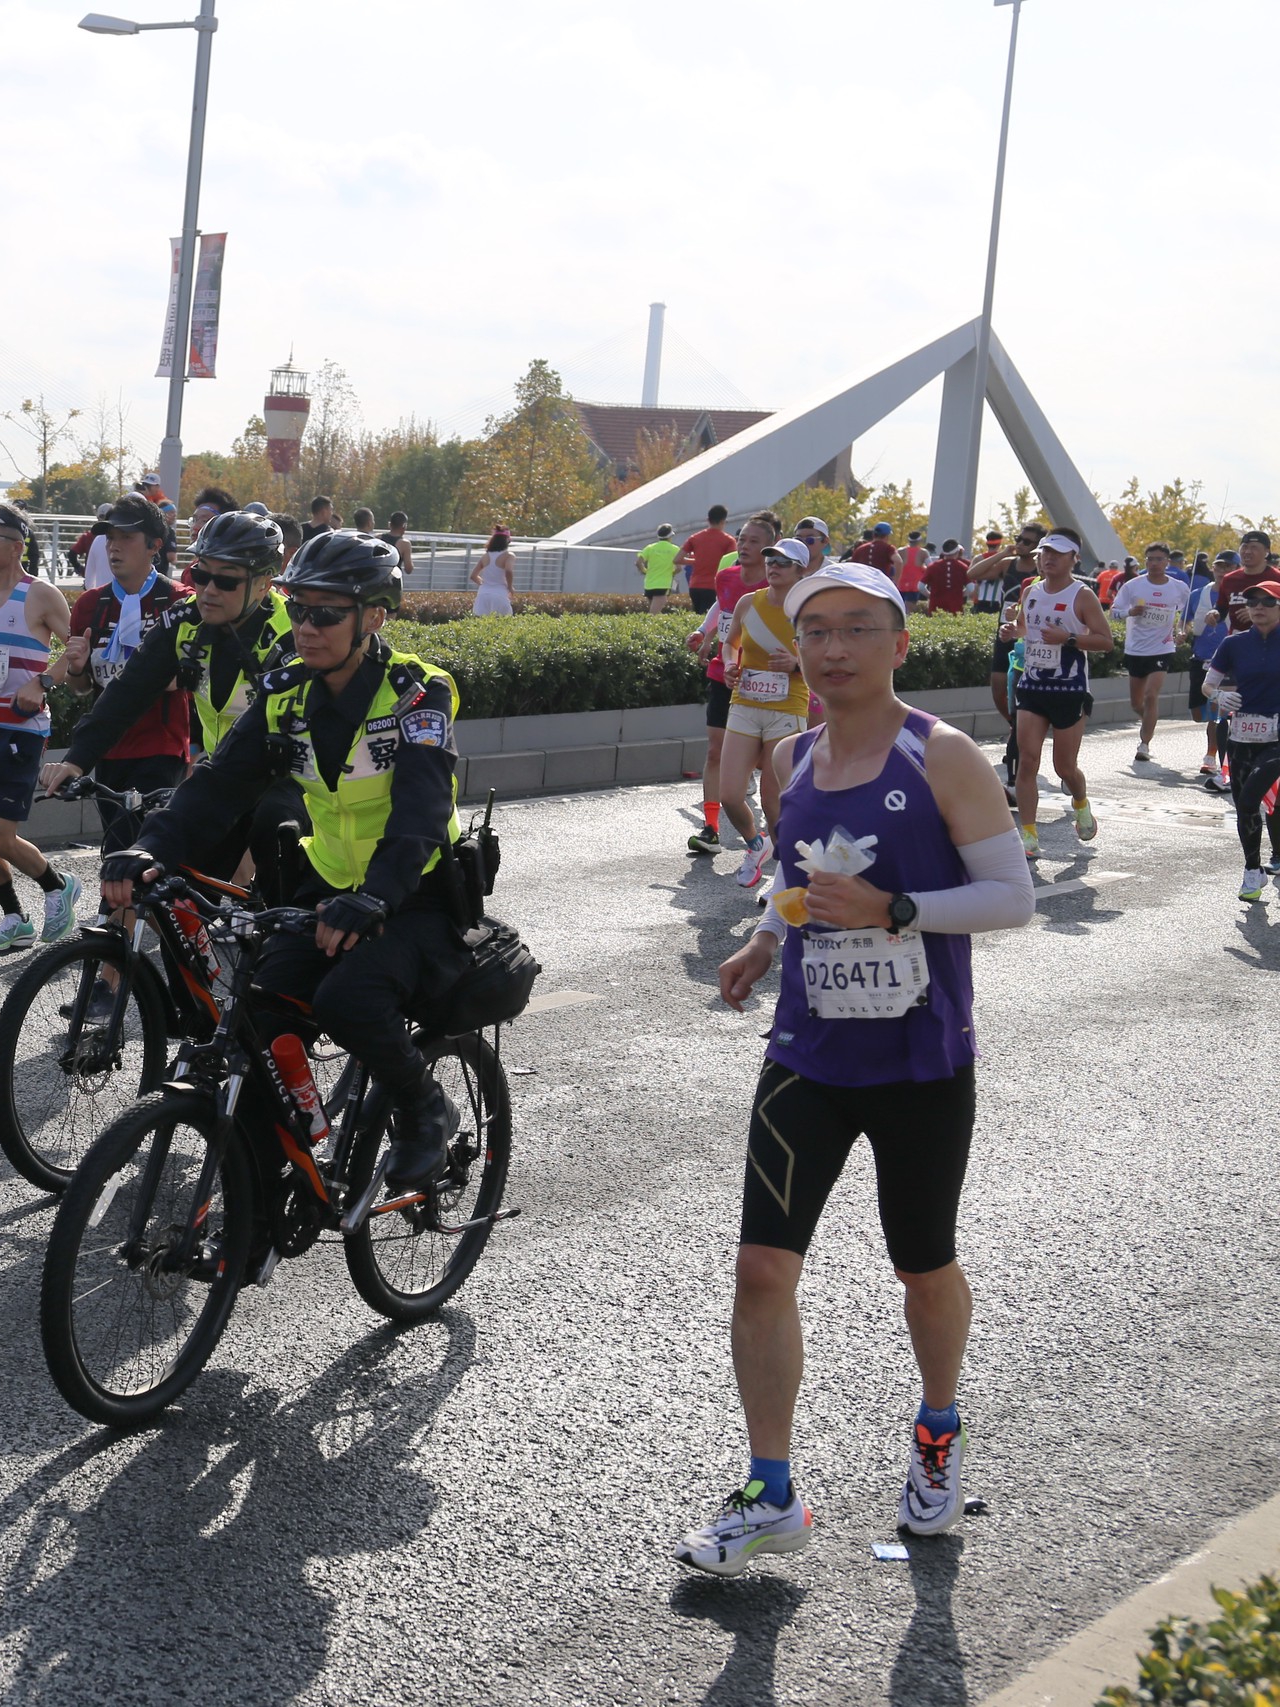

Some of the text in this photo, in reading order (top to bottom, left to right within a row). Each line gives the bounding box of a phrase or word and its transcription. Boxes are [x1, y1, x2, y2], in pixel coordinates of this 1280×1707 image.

[367, 717, 397, 732] 062007
[1241, 721, 1267, 733] 9475
[165, 904, 190, 950] POLICE
[851, 938, 874, 949] 东丽
[806, 960, 902, 990] D26471
[836, 1005, 894, 1013] VOLVO
[261, 1049, 290, 1104] POLICE
